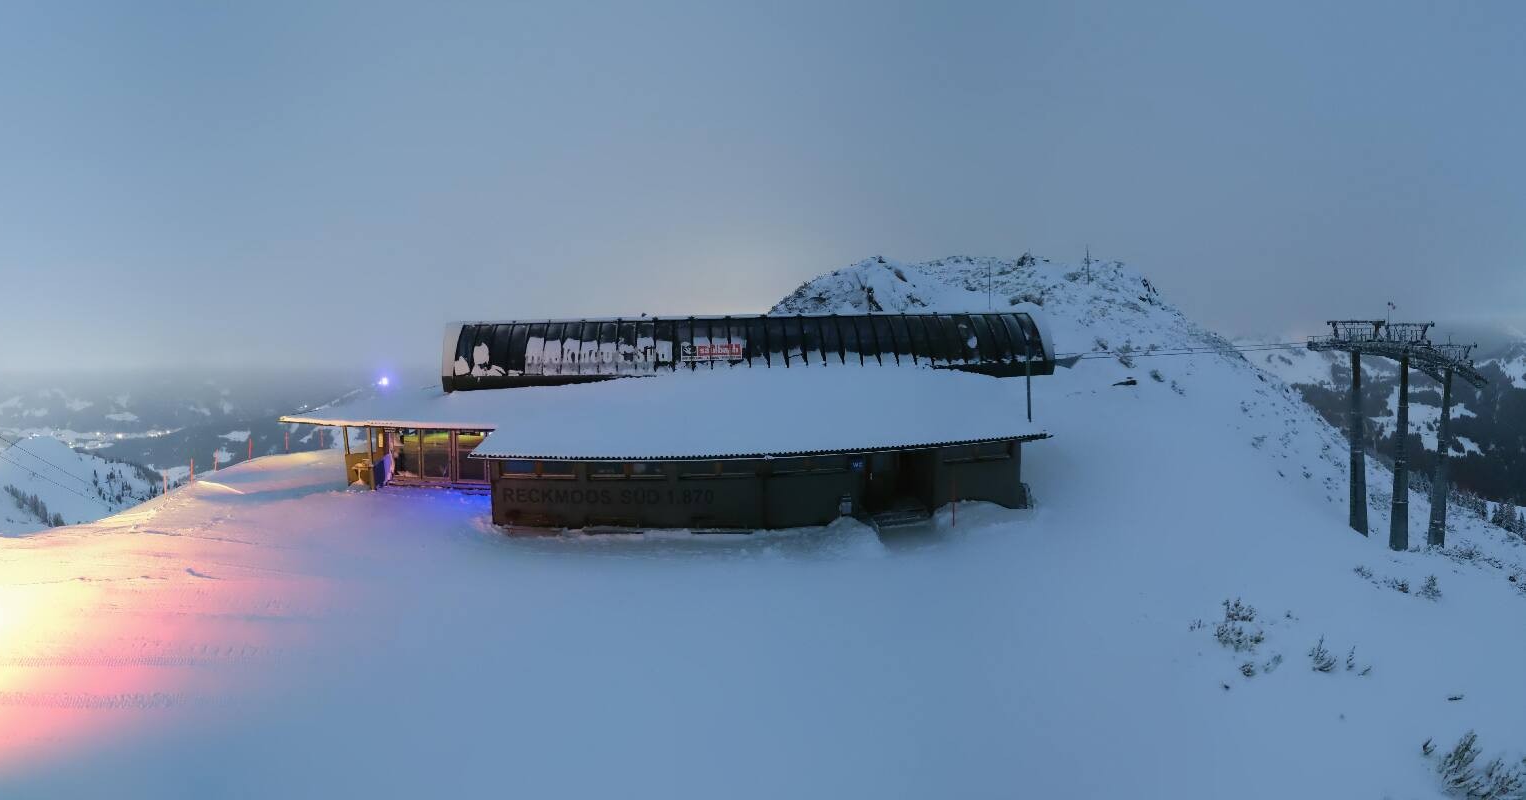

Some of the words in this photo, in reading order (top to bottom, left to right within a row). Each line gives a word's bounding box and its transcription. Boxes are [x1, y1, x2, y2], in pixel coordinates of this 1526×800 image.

[502, 487, 612, 505] RECKMOOS
[620, 486, 660, 505] SÜD
[667, 487, 715, 505] 1.870
